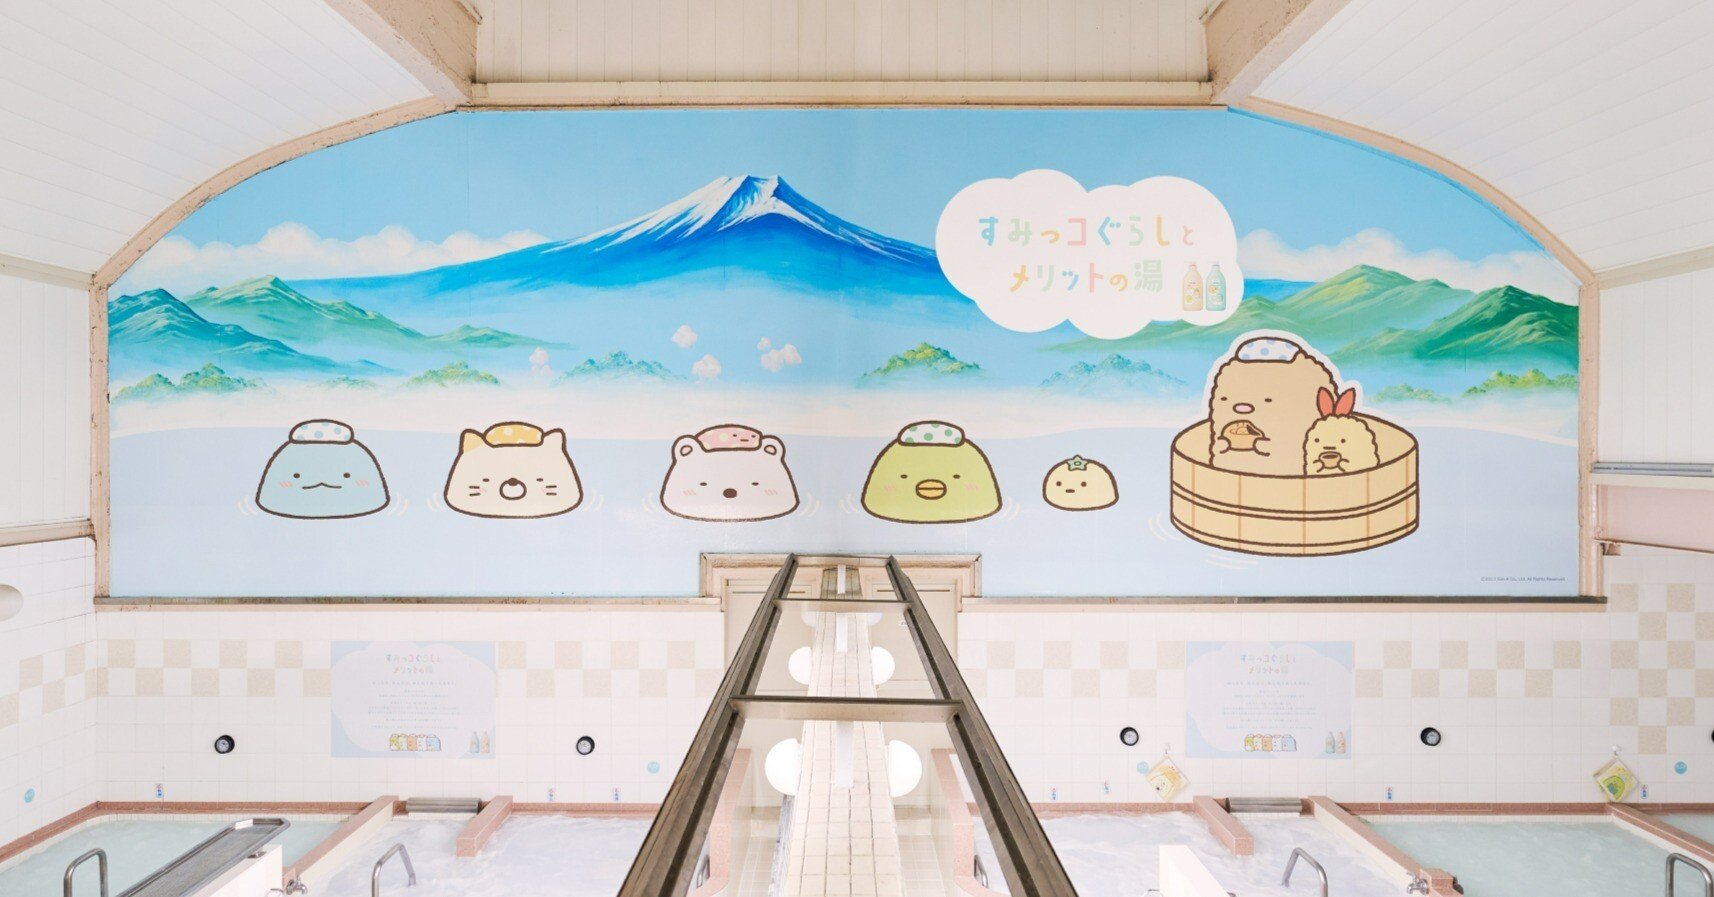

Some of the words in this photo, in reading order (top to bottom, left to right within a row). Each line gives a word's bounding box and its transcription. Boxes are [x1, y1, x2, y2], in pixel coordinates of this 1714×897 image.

[978, 215, 1194, 247] すみっコぐらしと
[1010, 260, 1163, 293] メリットの湯
